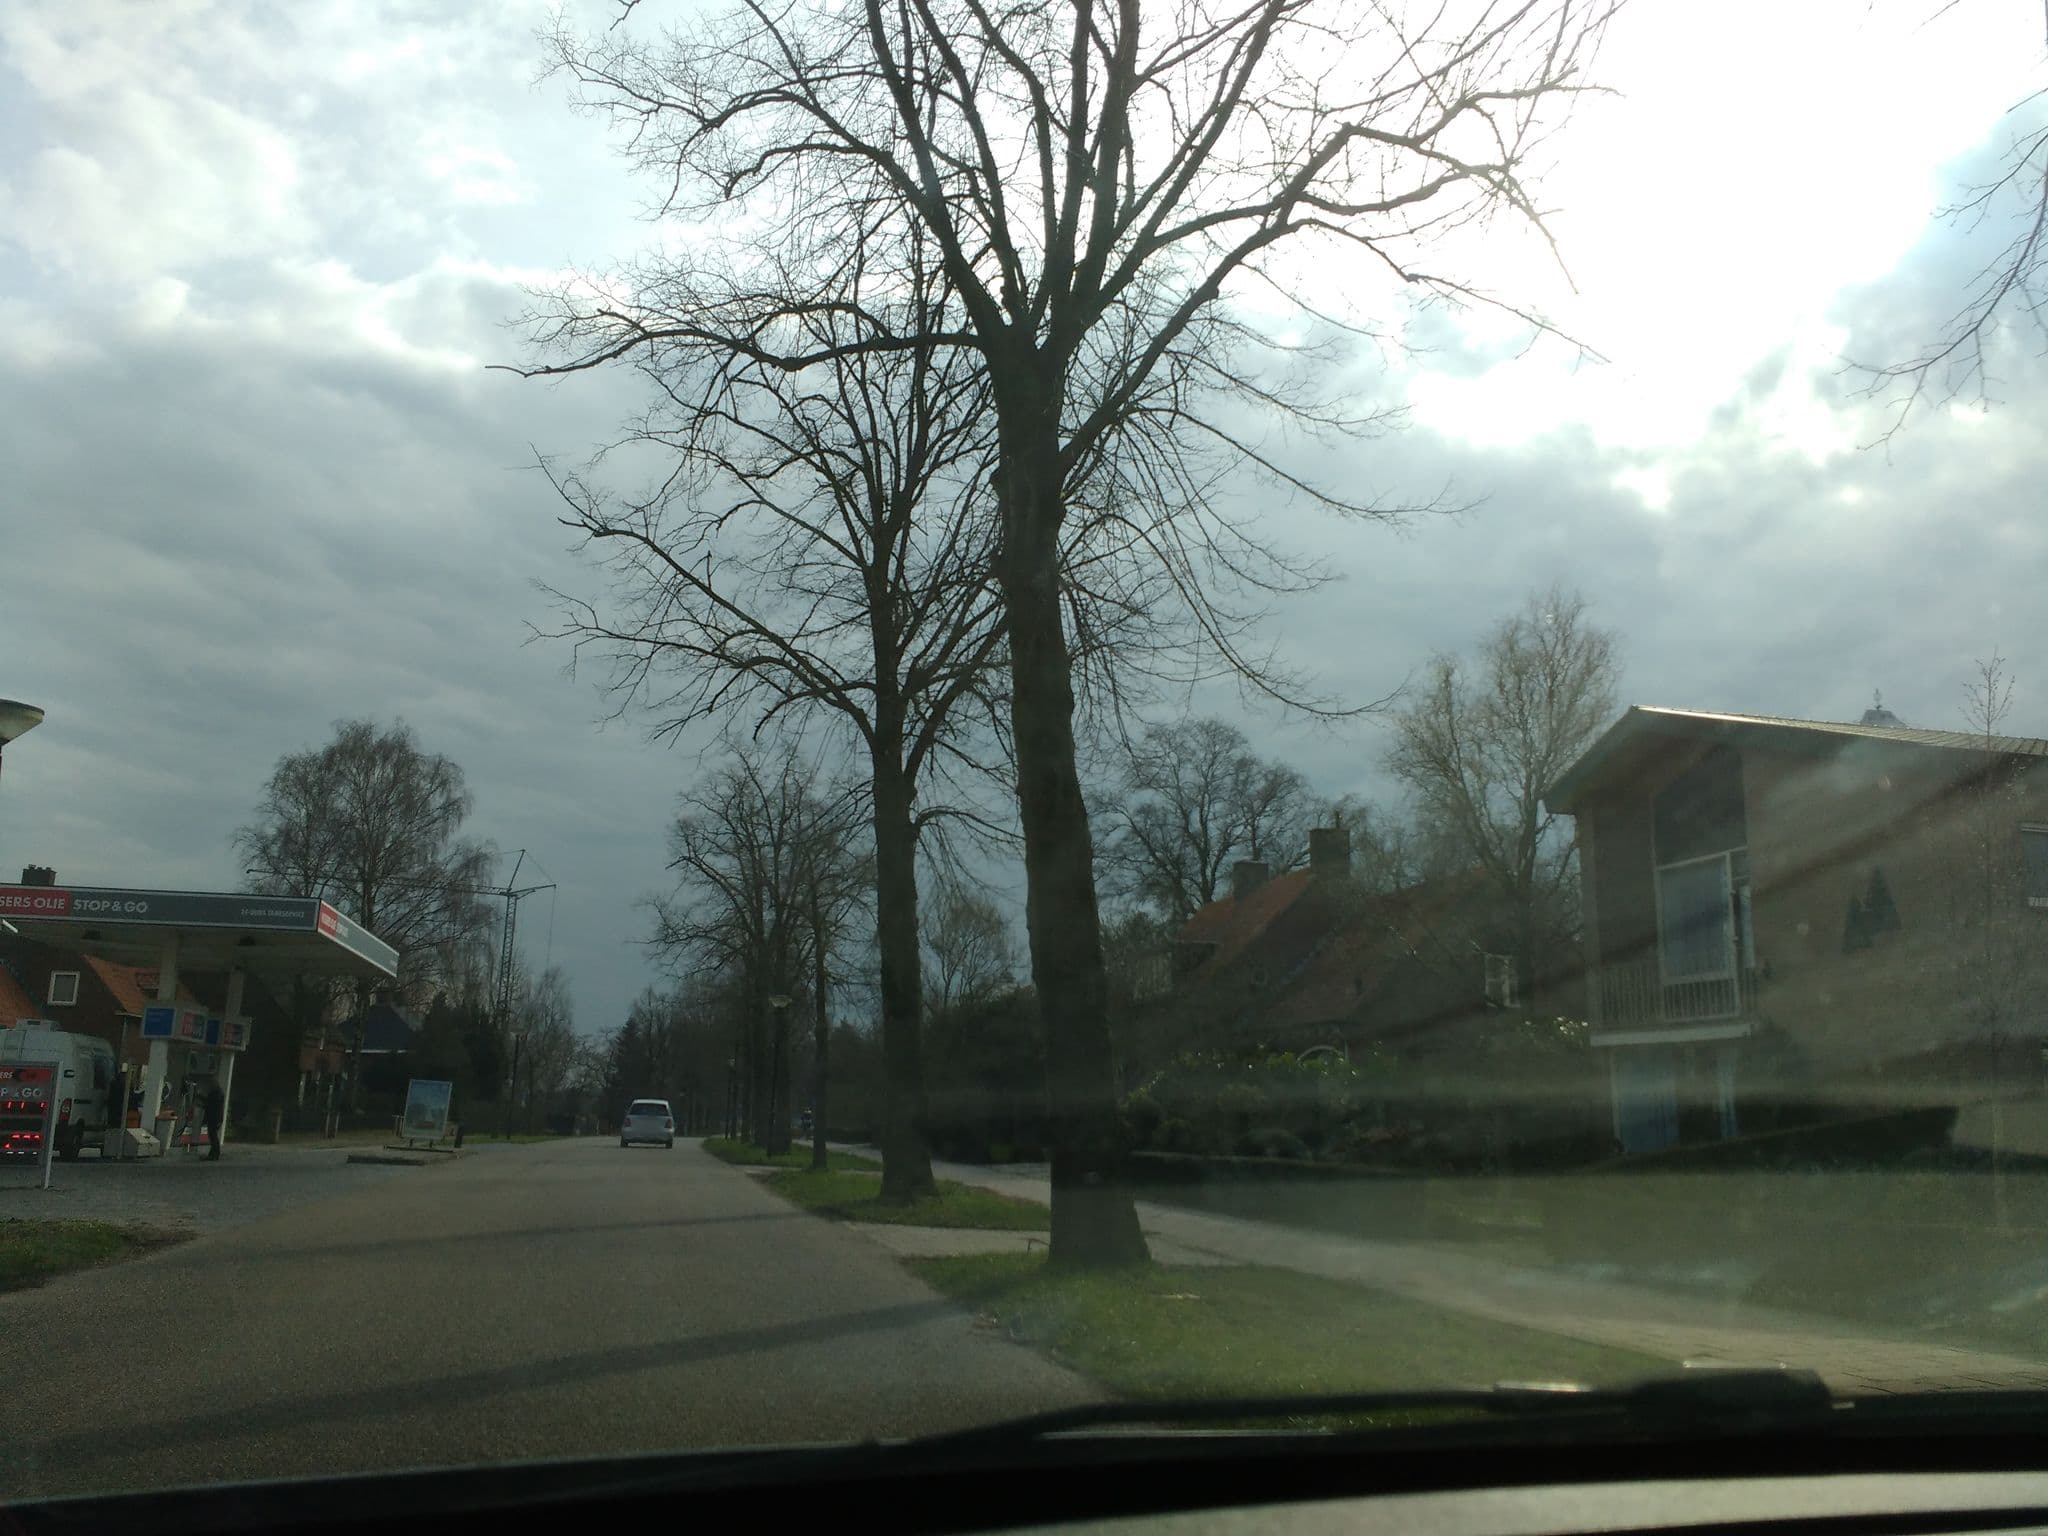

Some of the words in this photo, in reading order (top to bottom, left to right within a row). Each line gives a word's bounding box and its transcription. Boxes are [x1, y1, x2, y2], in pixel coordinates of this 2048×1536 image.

[34, 897, 65, 910] OLIE
[73, 899, 110, 912] STOP
[111, 901, 122, 912] &
[124, 901, 149, 913] GO
